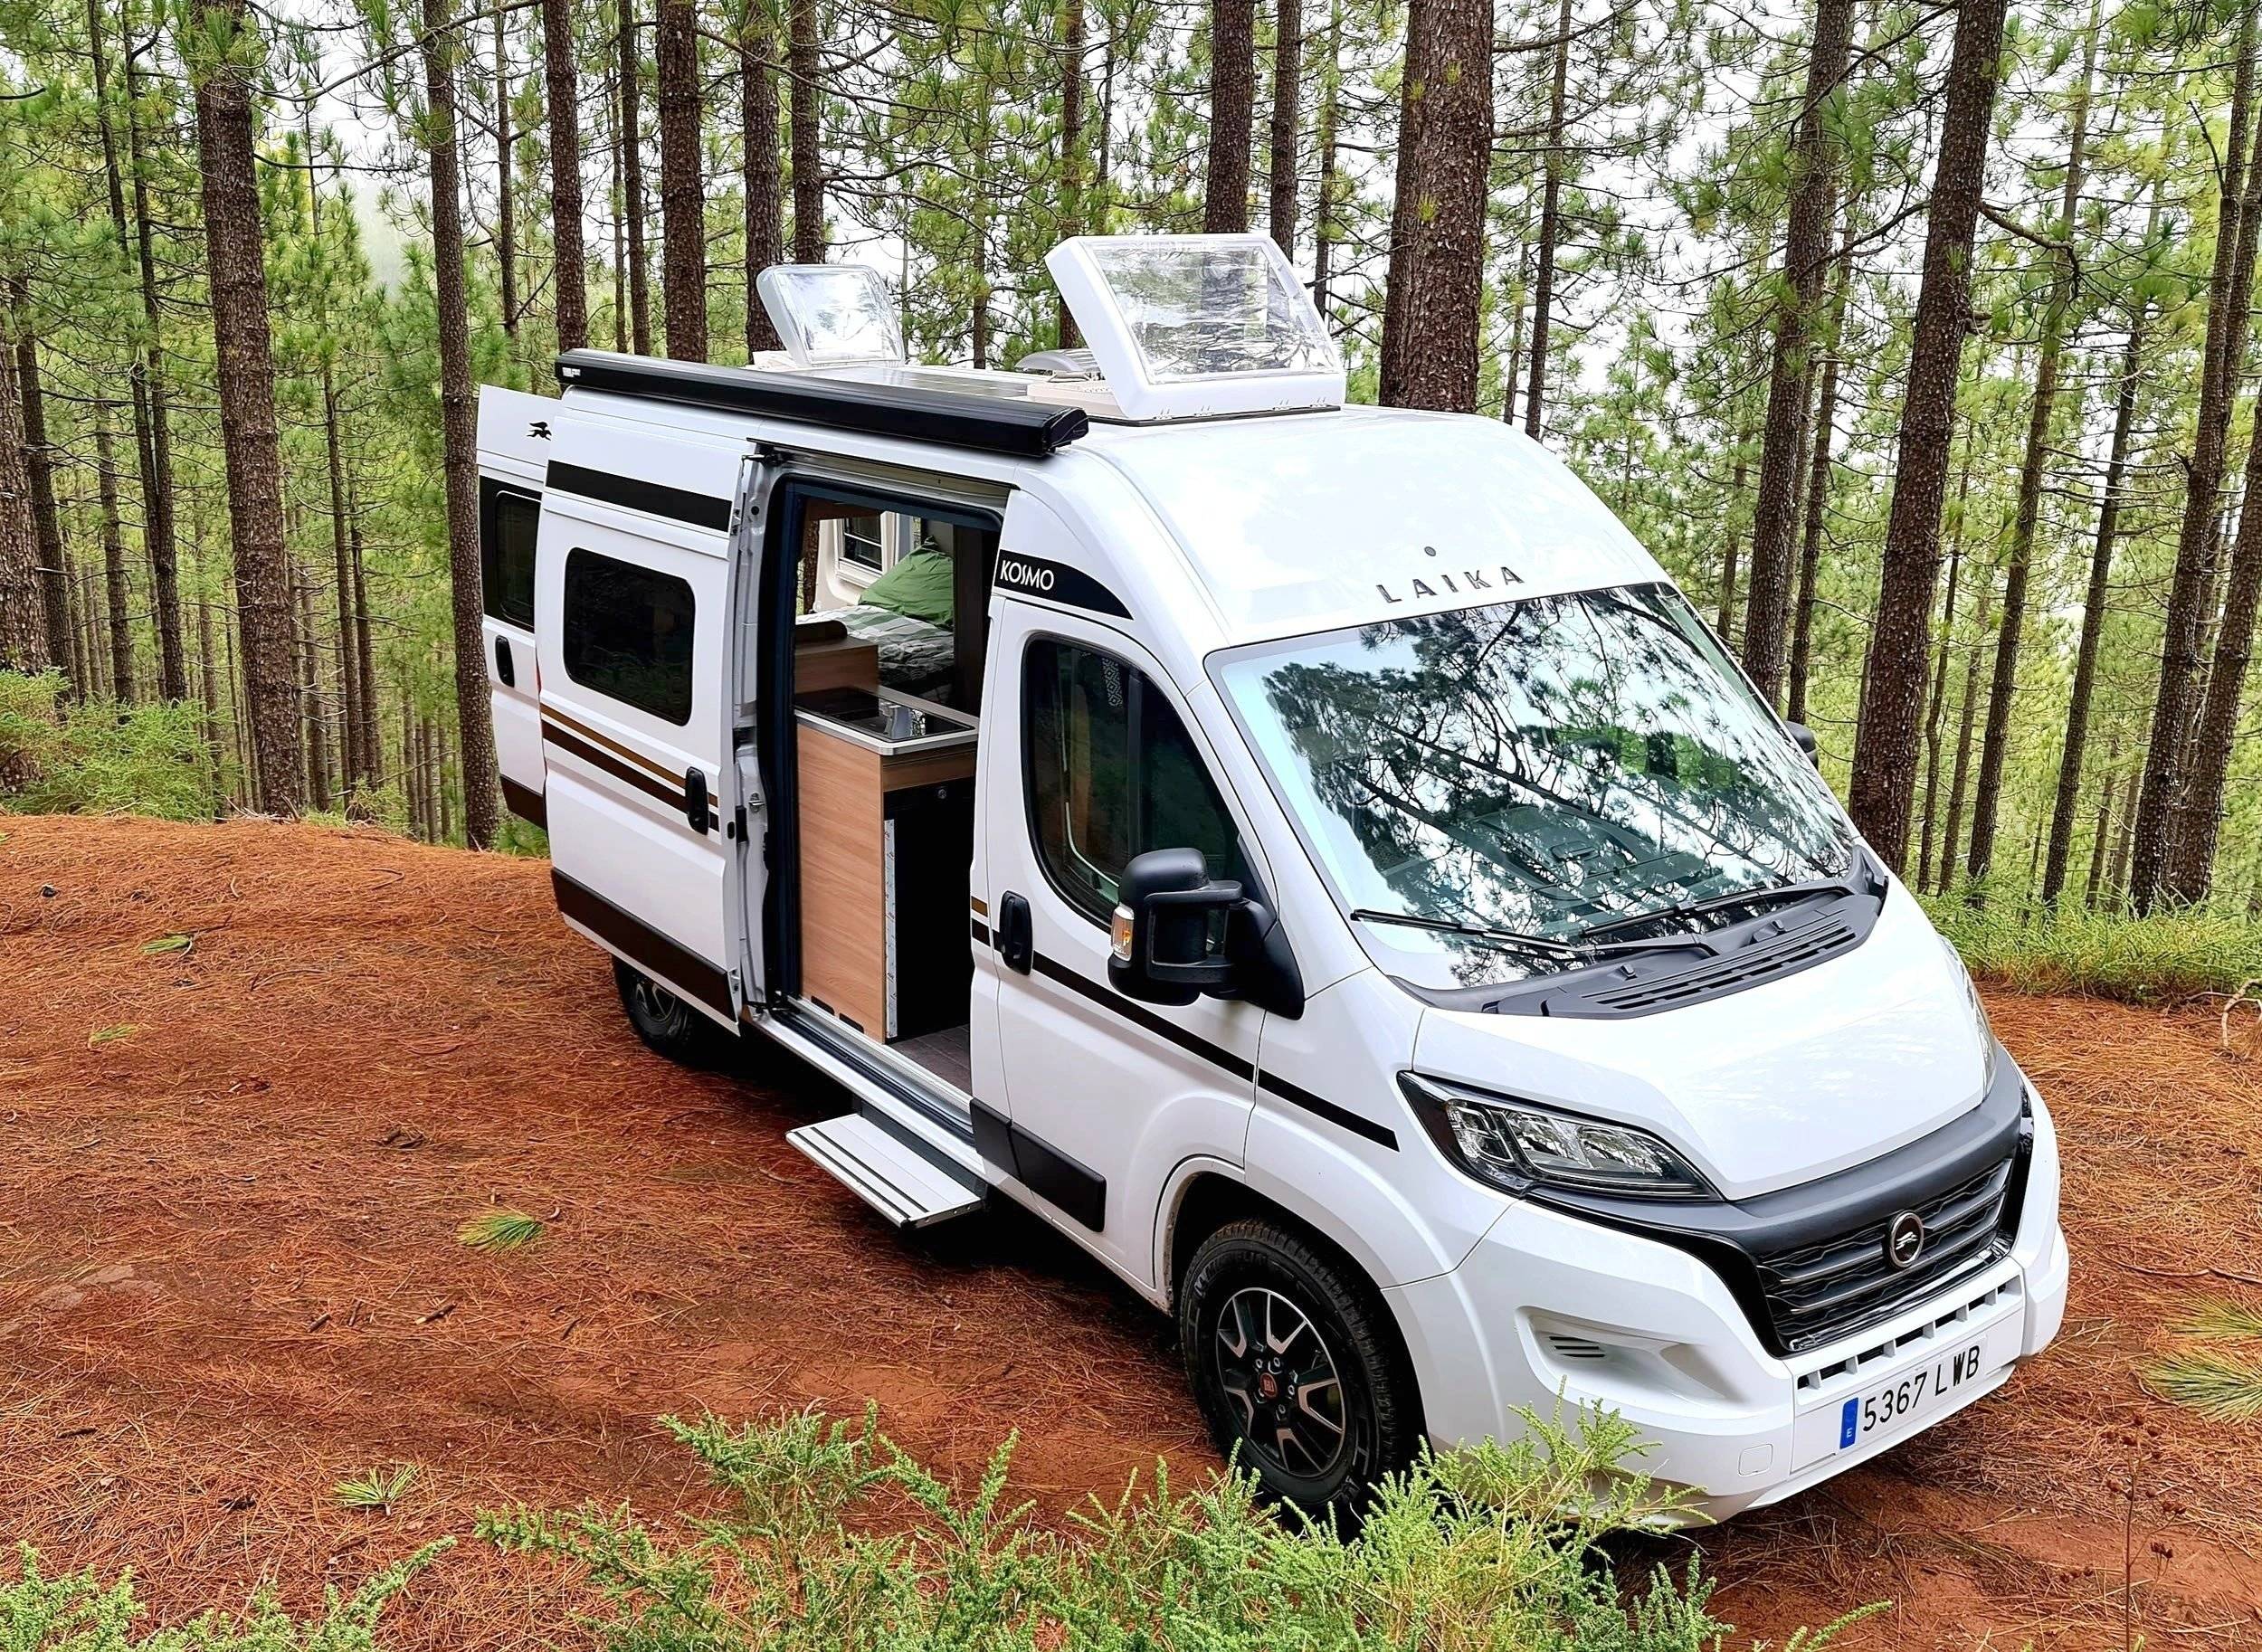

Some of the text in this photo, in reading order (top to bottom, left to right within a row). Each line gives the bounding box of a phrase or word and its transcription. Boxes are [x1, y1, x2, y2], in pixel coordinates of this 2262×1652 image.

[1000, 559, 1055, 591] KOSMO
[1375, 566, 1525, 603] LAIKA
[1862, 1345, 1981, 1432] 5367 LWB
[1846, 1427, 1853, 1438] E
